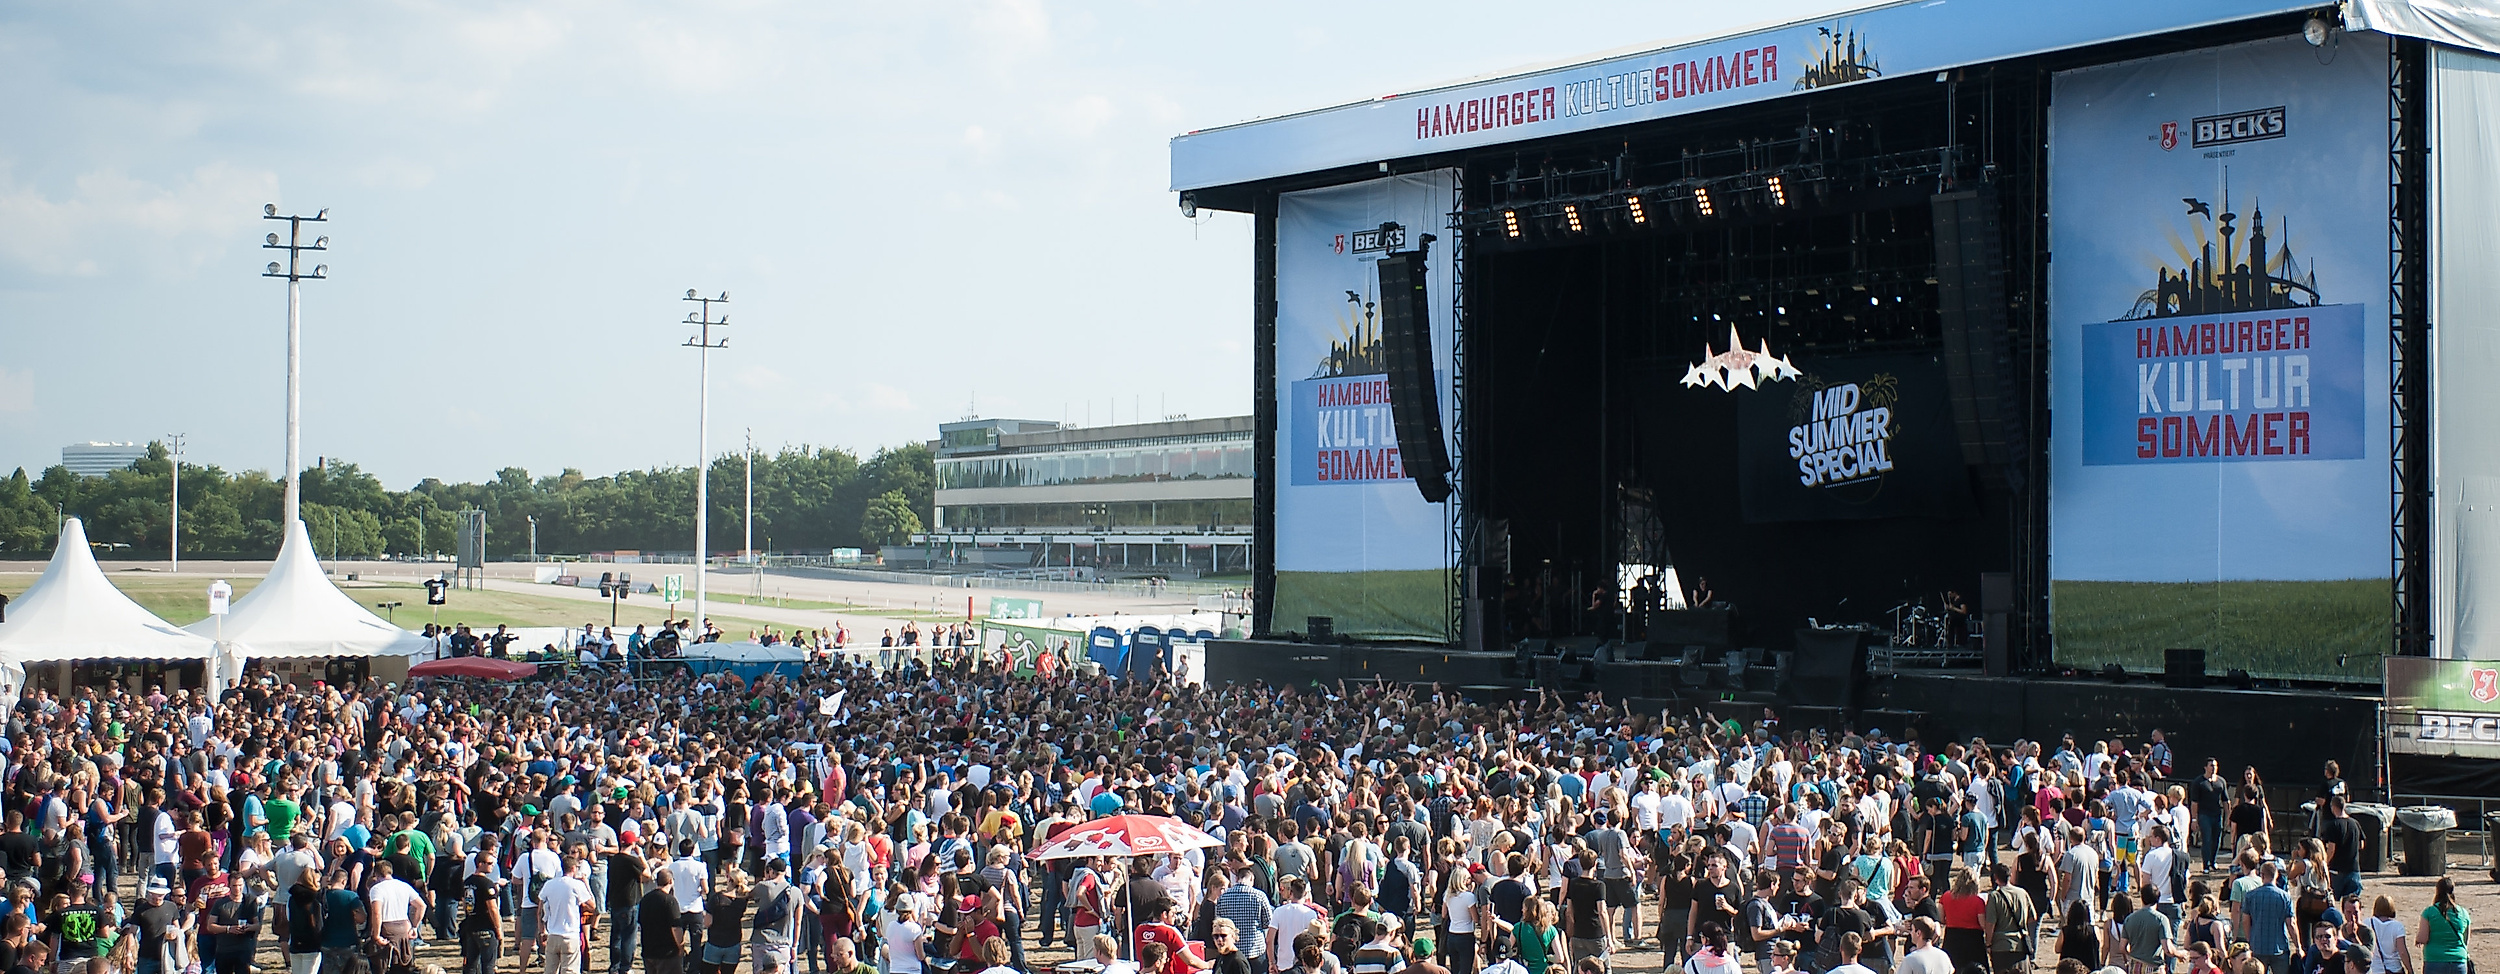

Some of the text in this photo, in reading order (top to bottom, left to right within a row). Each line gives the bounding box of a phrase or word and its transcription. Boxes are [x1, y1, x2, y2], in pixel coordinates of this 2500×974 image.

[1417, 86, 1556, 140] HAMBURGER
[2196, 109, 2283, 143] BECK'S
[2136, 316, 2310, 359] HAMBURGER
[1318, 380, 1392, 408] HAMBURG
[1811, 382, 1862, 423] MID
[2137, 354, 2310, 415] KULTUR
[1318, 407, 1396, 448] KULTU
[1789, 405, 1892, 461] SUMMER
[2136, 411, 2310, 459] SOMMER
[1317, 448, 1406, 482] SOMME
[1799, 439, 1894, 489] SPECIAL
[2421, 714, 2500, 740] BEC
